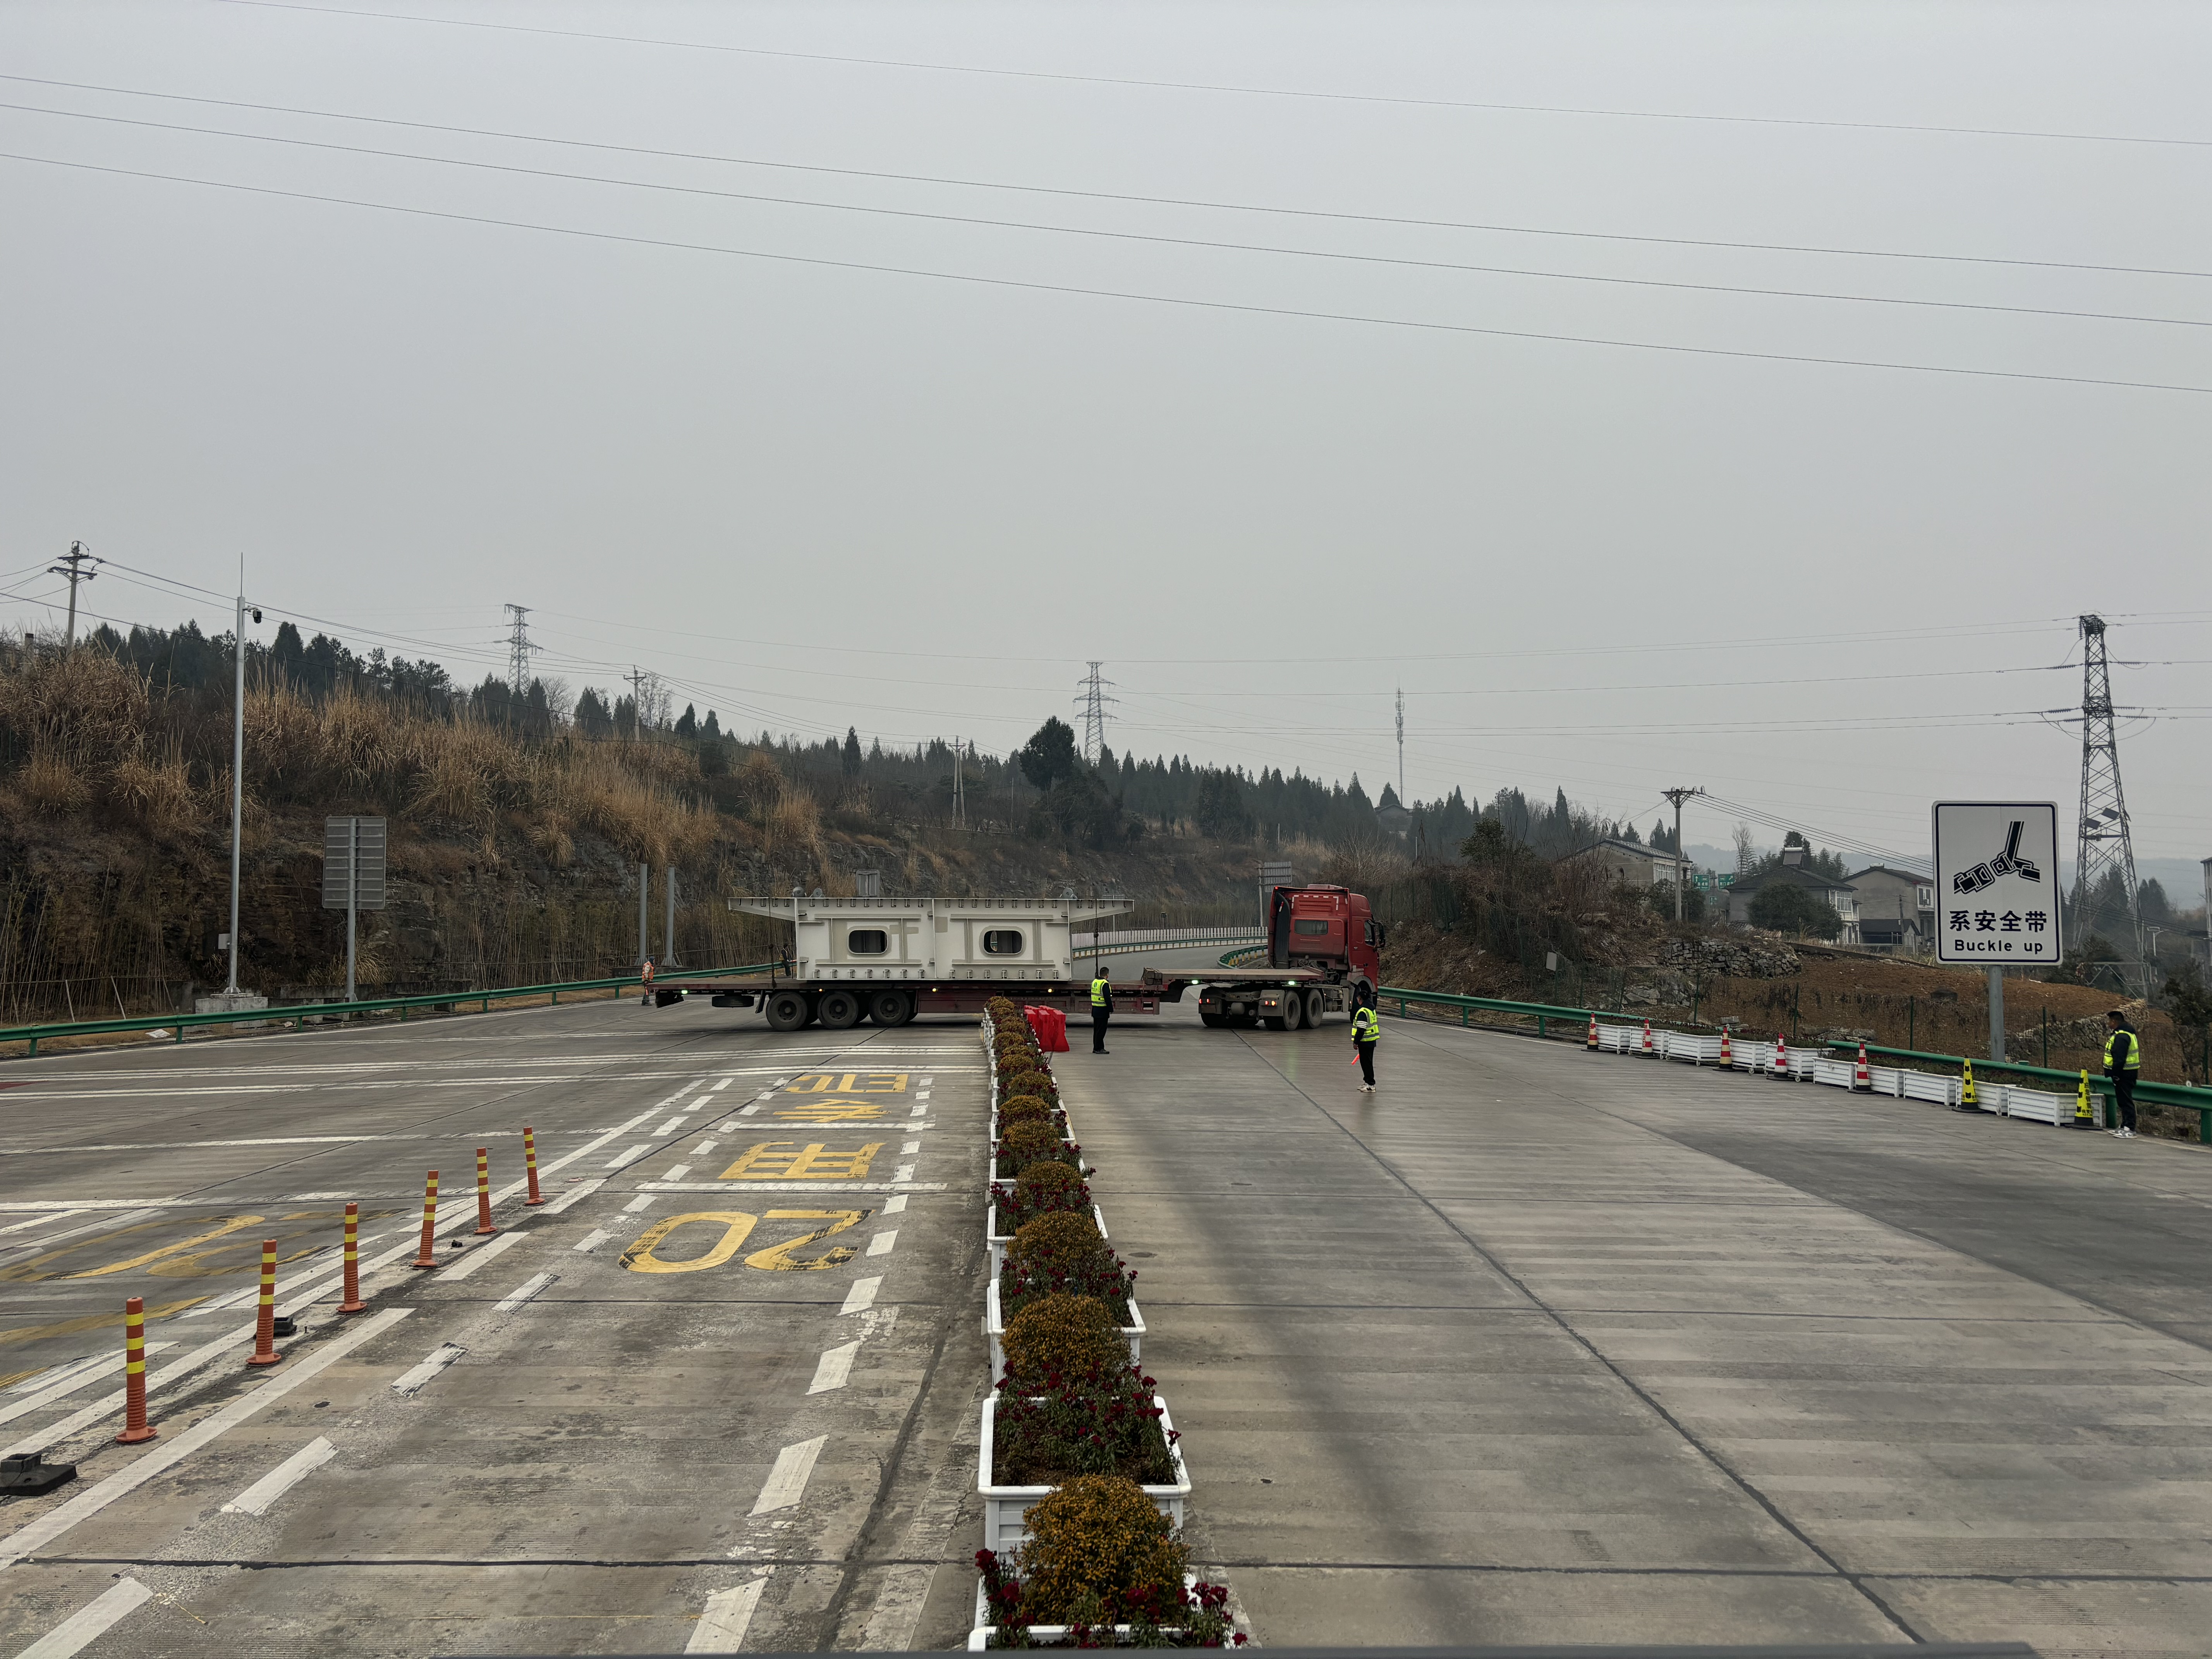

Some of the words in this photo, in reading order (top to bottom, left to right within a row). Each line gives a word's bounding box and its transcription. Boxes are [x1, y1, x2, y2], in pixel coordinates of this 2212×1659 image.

[1949, 910, 2047, 933] 系安全带
[1955, 939, 2012, 951] Buckle
[2024, 942, 2043, 954] up
[785, 1073, 908, 1093] ETC
[619, 1209, 876, 1274] 20
